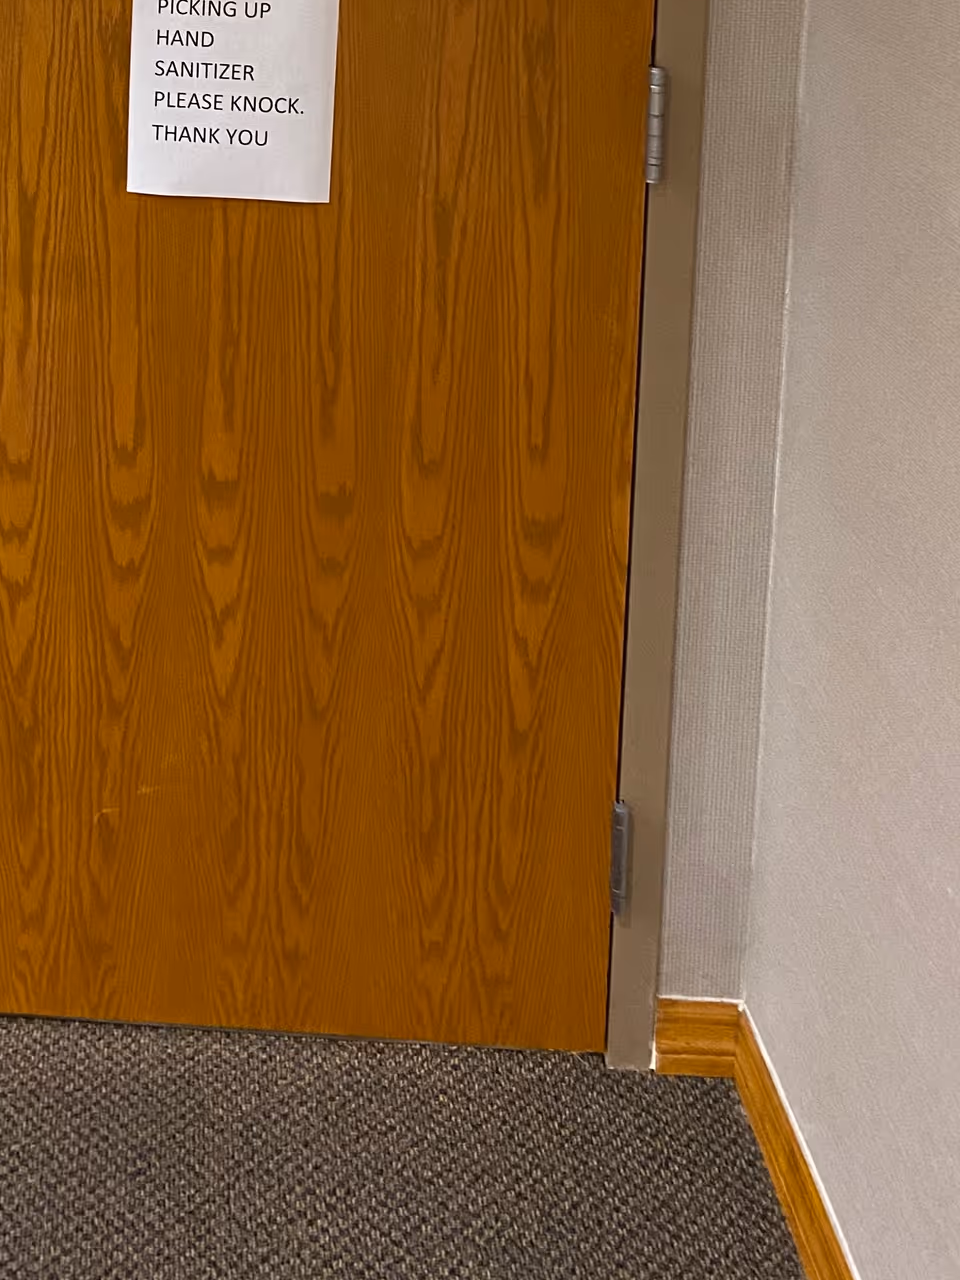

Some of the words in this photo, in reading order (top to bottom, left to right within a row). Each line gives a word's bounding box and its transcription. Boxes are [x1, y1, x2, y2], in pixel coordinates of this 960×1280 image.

[244, 2, 271, 18] UP
[156, 29, 214, 48] HAND
[154, 60, 255, 81] SANITIZER
[154, 91, 224, 110] PLEASE
[230, 96, 304, 114] KNOCK.
[152, 124, 220, 144] THANK
[226, 128, 268, 146] YOU
